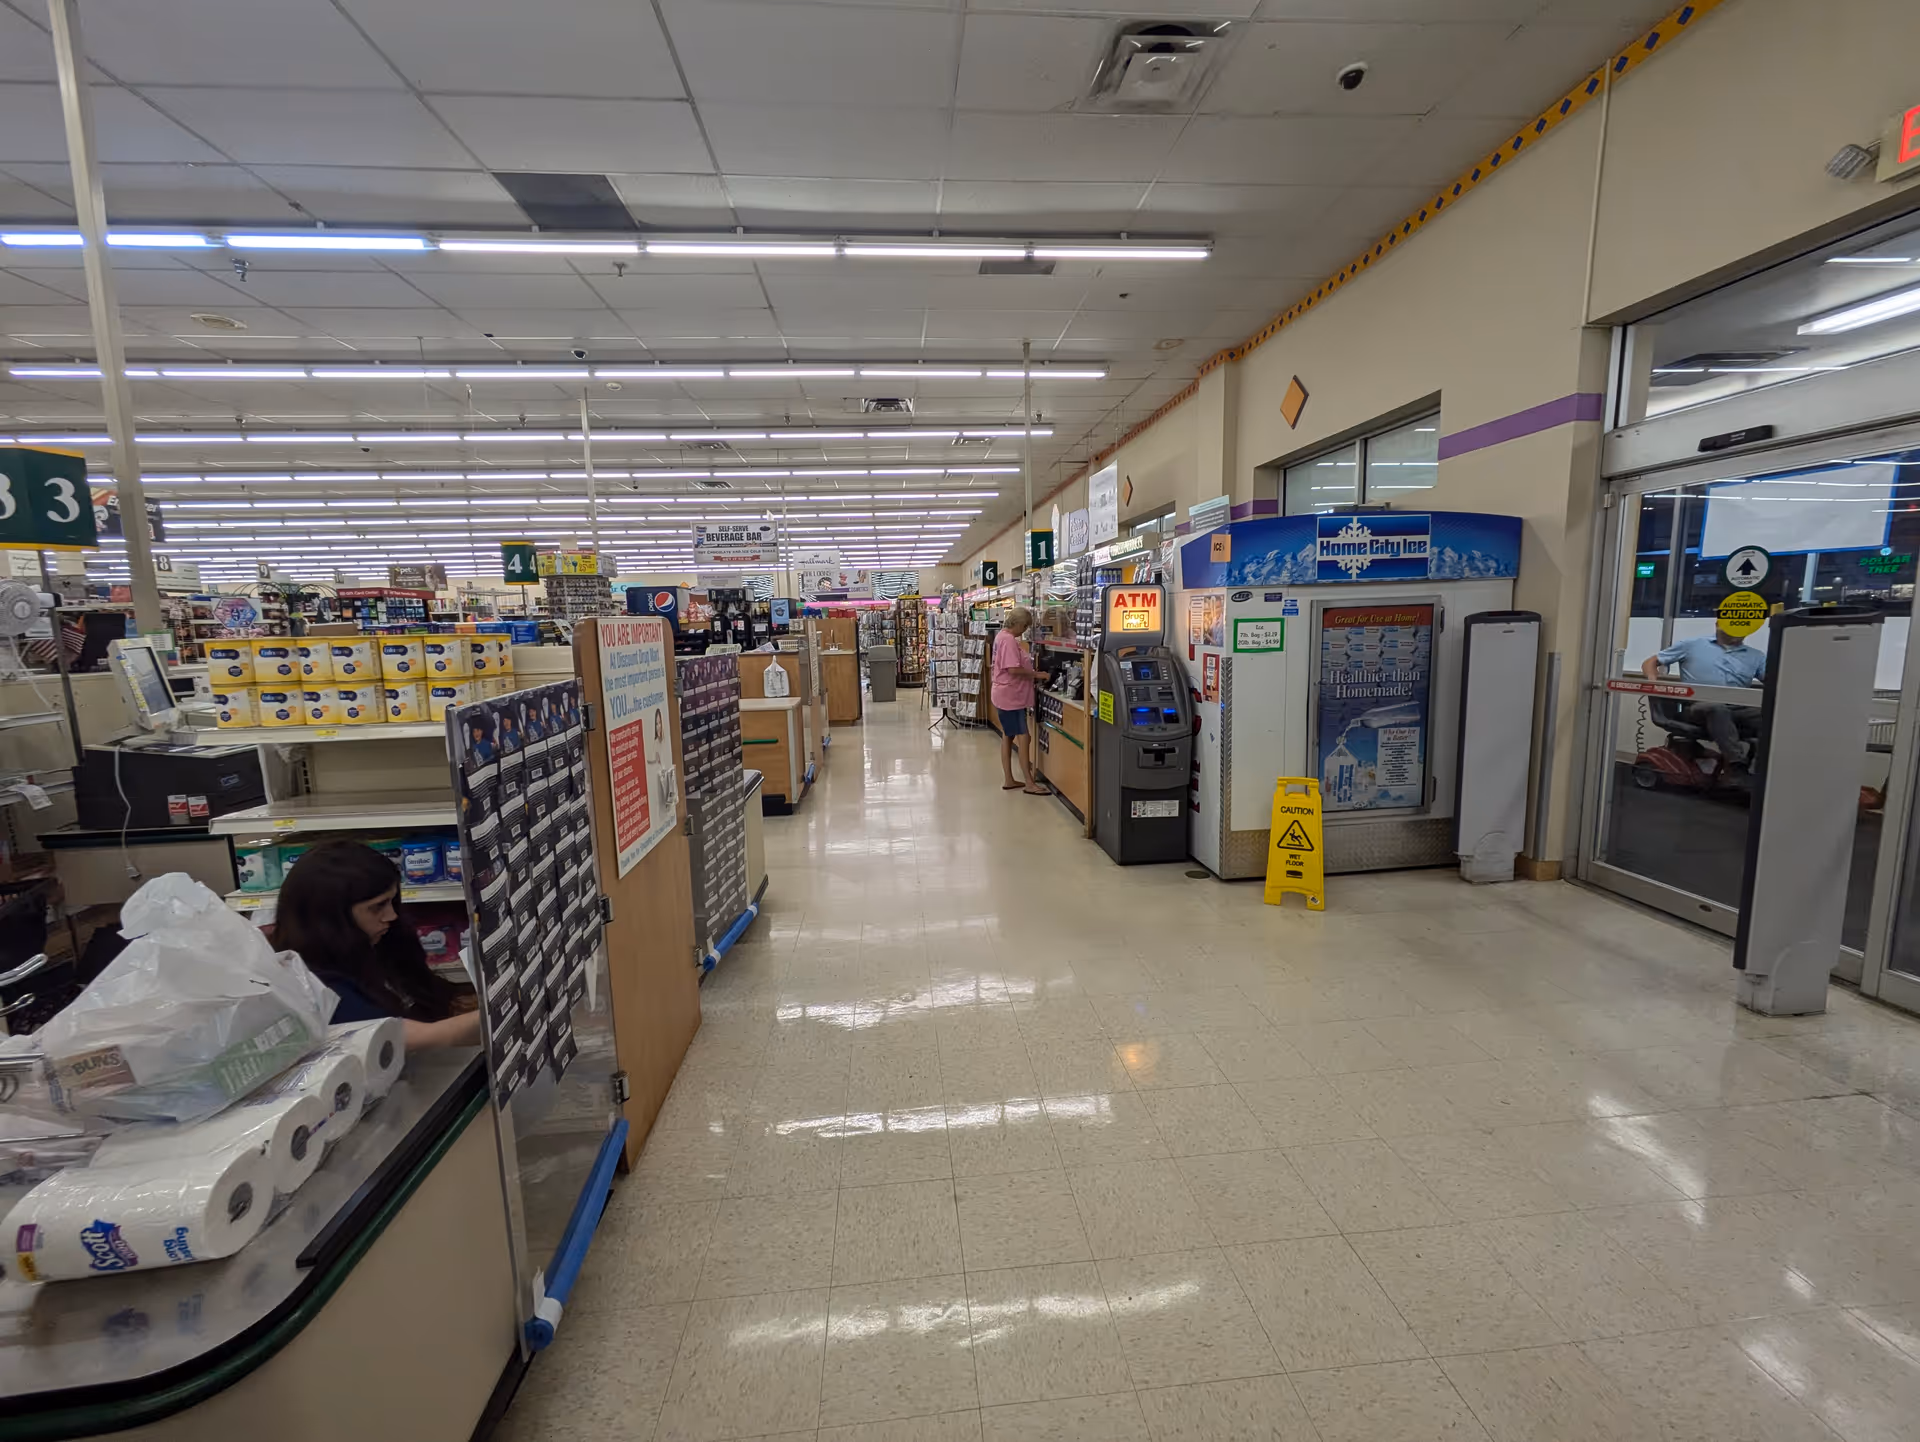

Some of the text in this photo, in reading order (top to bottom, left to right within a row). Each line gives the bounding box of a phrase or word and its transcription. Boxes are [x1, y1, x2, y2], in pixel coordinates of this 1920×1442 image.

[44, 477, 80, 522] 3
[706, 532, 762, 542] BEVERAGE BAR
[1037, 540, 1048, 560] 1
[1213, 542, 1222, 551] ICE
[1319, 538, 1428, 557] Home City Ice
[159, 556, 169, 570] 8
[260, 563, 268, 578] 9
[507, 553, 536, 573] 4 4
[985, 567, 994, 580] 6
[647, 592, 655, 612] pepsi
[1114, 593, 1156, 608] ATM
[1125, 611, 1145, 622] drug
[1334, 615, 1355, 624] Great
[1356, 614, 1368, 625] for
[1370, 615, 1382, 623] Use
[1394, 612, 1420, 622] Home!
[1720, 610, 1764, 619] CAUTION
[1126, 620, 1150, 628] mart
[600, 622, 662, 647] YOU ARE IMPORTANT
[617, 650, 638, 669] Discount
[639, 648, 650, 667] Drug
[614, 673, 627, 689] most
[1330, 668, 1420, 684] Healthier than
[1336, 681, 1412, 698] Homemade!
[1280, 805, 1314, 815] CAUTION
[82, 1231, 125, 1268] Scott
[163, 1239, 182, 1262] Long
